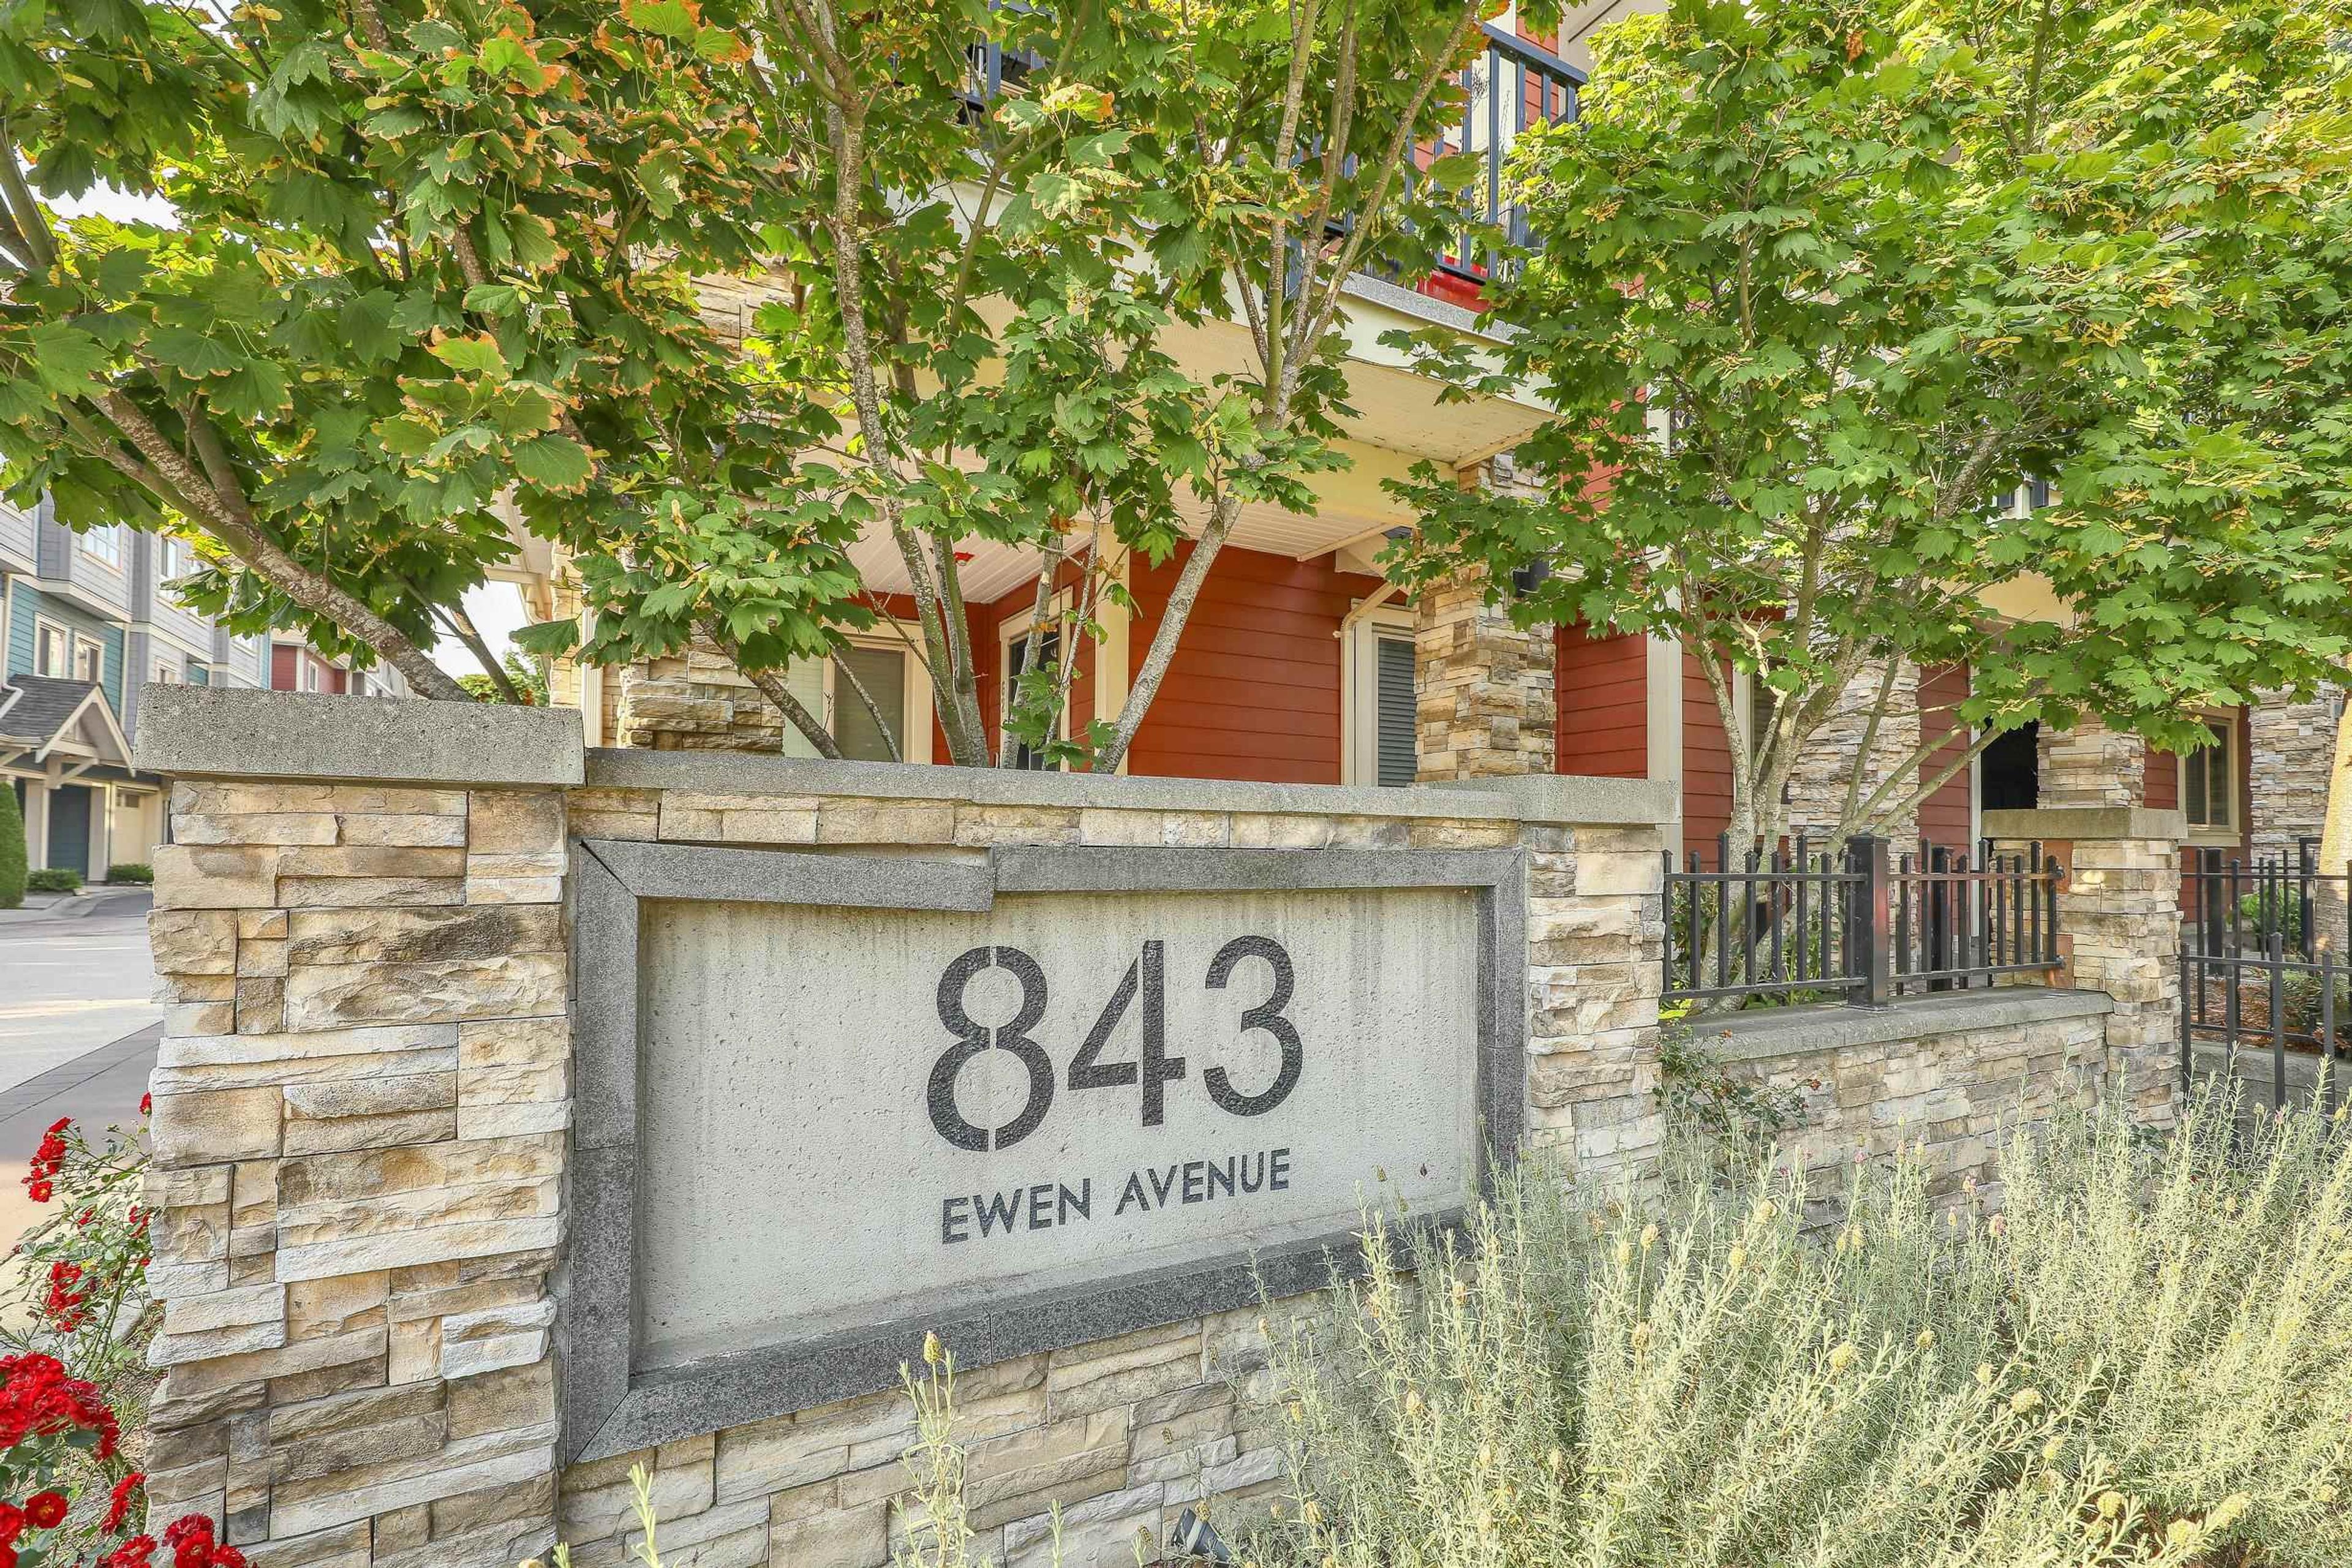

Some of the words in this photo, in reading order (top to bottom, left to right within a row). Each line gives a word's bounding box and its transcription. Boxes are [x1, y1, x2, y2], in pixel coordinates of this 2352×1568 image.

[927, 935, 1303, 1152] 843
[943, 1178, 1090, 1244] EWEN
[1115, 1148, 1290, 1215] AVENUE
